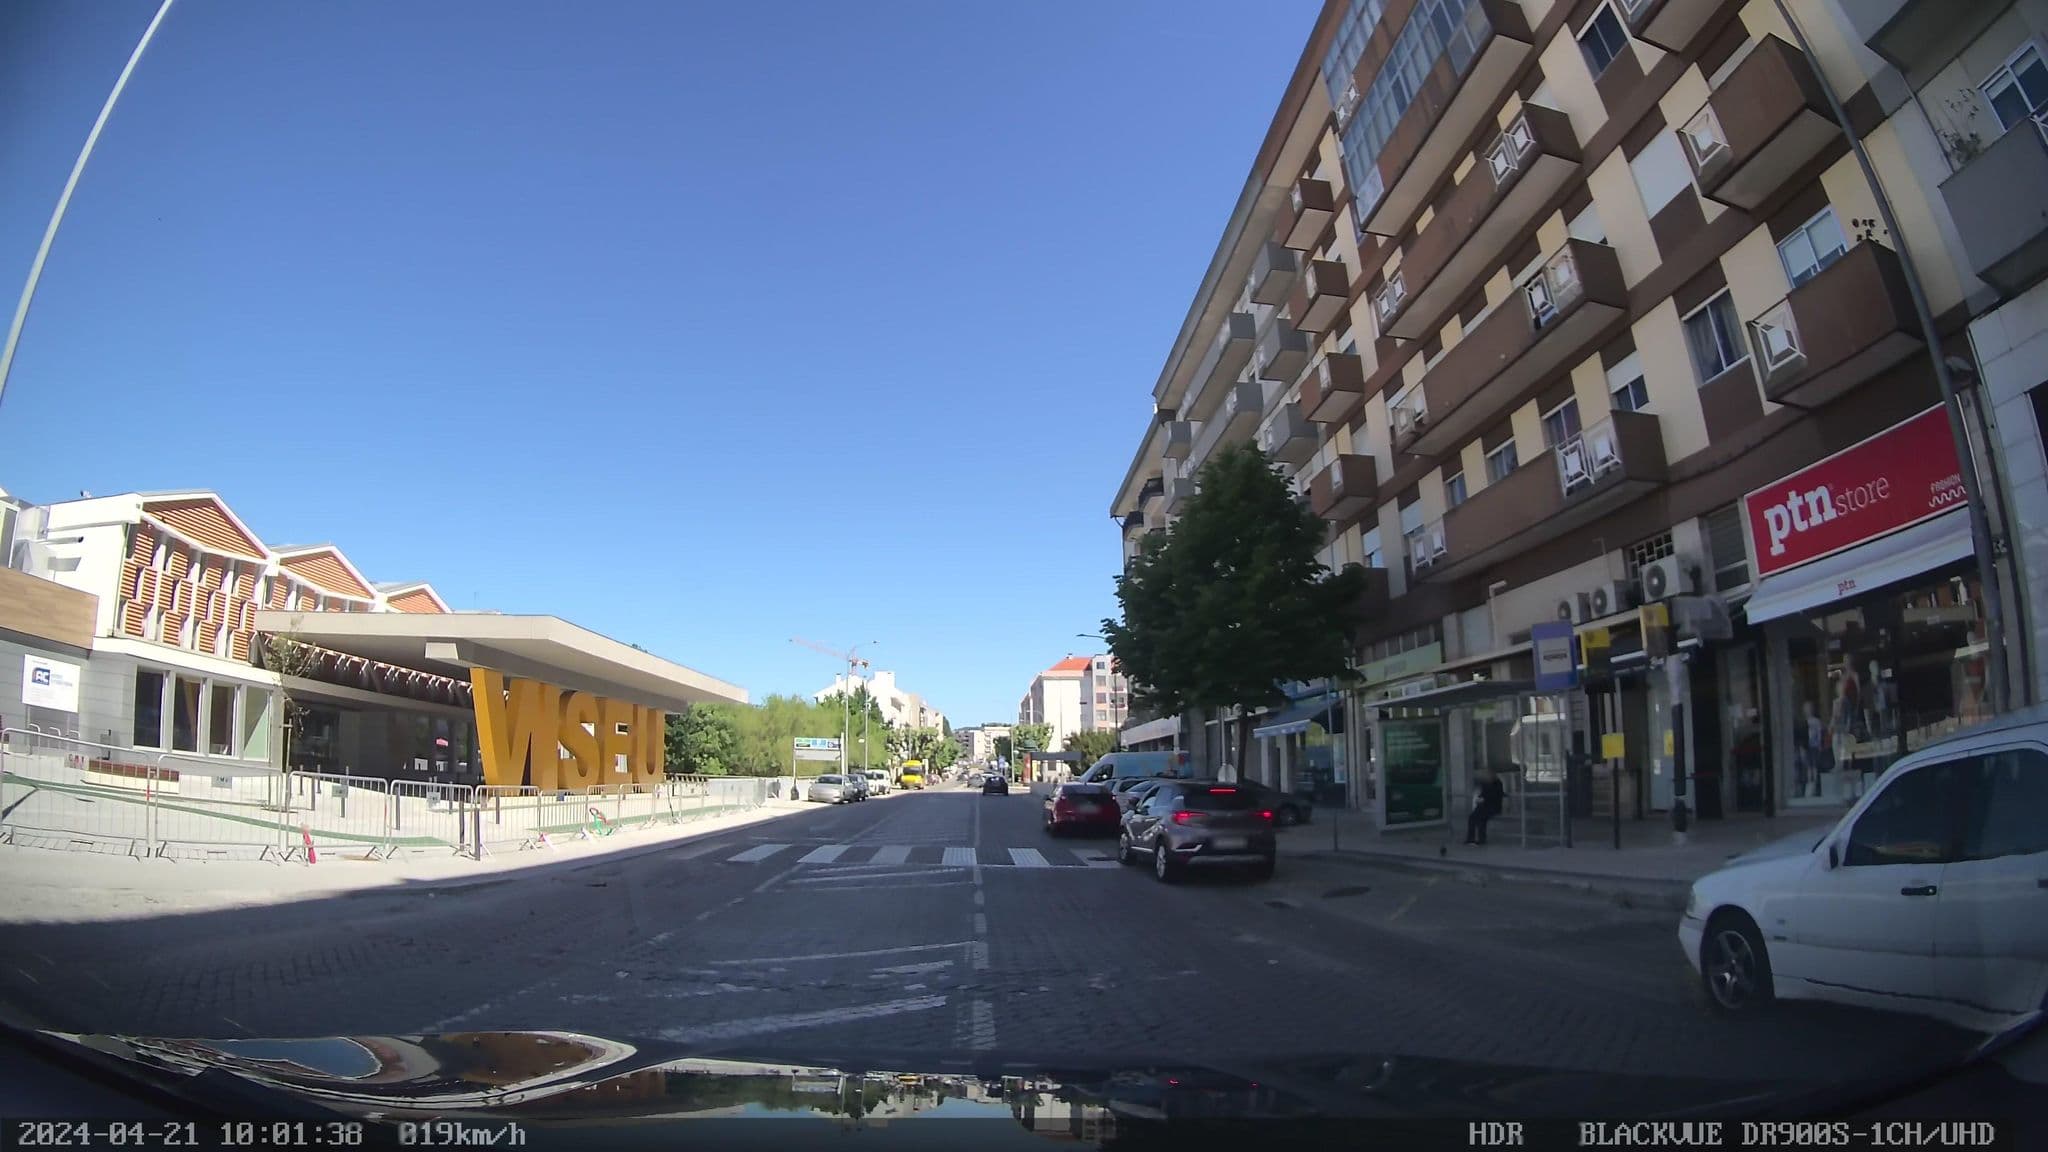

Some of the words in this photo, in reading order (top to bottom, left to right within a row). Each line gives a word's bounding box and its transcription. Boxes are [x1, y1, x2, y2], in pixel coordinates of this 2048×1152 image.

[1764, 484, 1838, 556] ptn
[1835, 476, 1889, 518] store
[1837, 577, 1856, 595] ptn
[470, 667, 665, 796] VISEU
